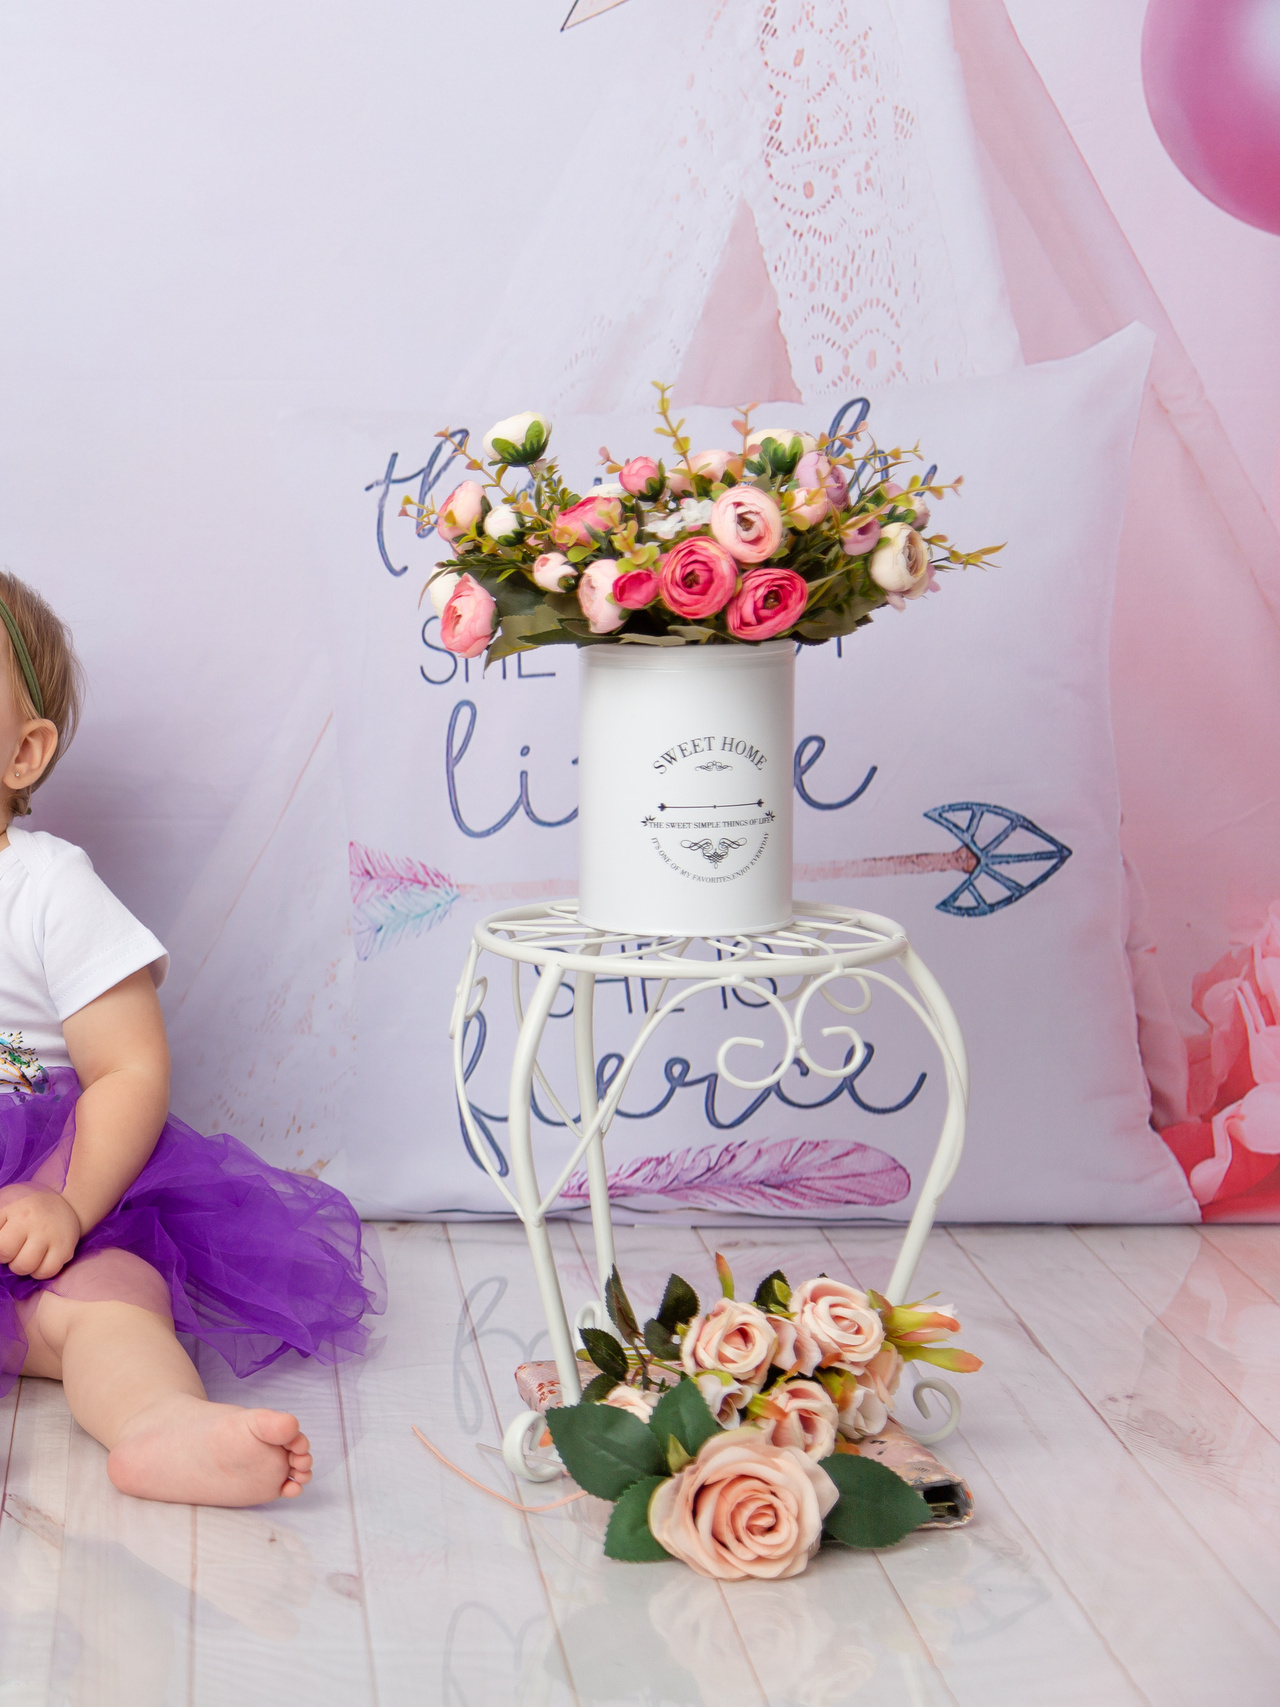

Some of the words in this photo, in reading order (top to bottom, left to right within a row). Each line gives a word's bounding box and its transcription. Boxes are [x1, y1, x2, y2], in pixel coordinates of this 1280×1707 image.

[652, 736, 716, 775] SWEET
[721, 736, 768, 771] HOME
[649, 821, 664, 829] THE
[693, 821, 721, 829] SIMPLE
[722, 820, 749, 828] THINGS
[749, 818, 758, 826] OF
[758, 816, 771, 825] LIFE
[659, 849, 673, 865] ONE
[670, 863, 681, 873] OF
[680, 869, 692, 878] MY
[750, 832, 770, 866] EVERYDAY
